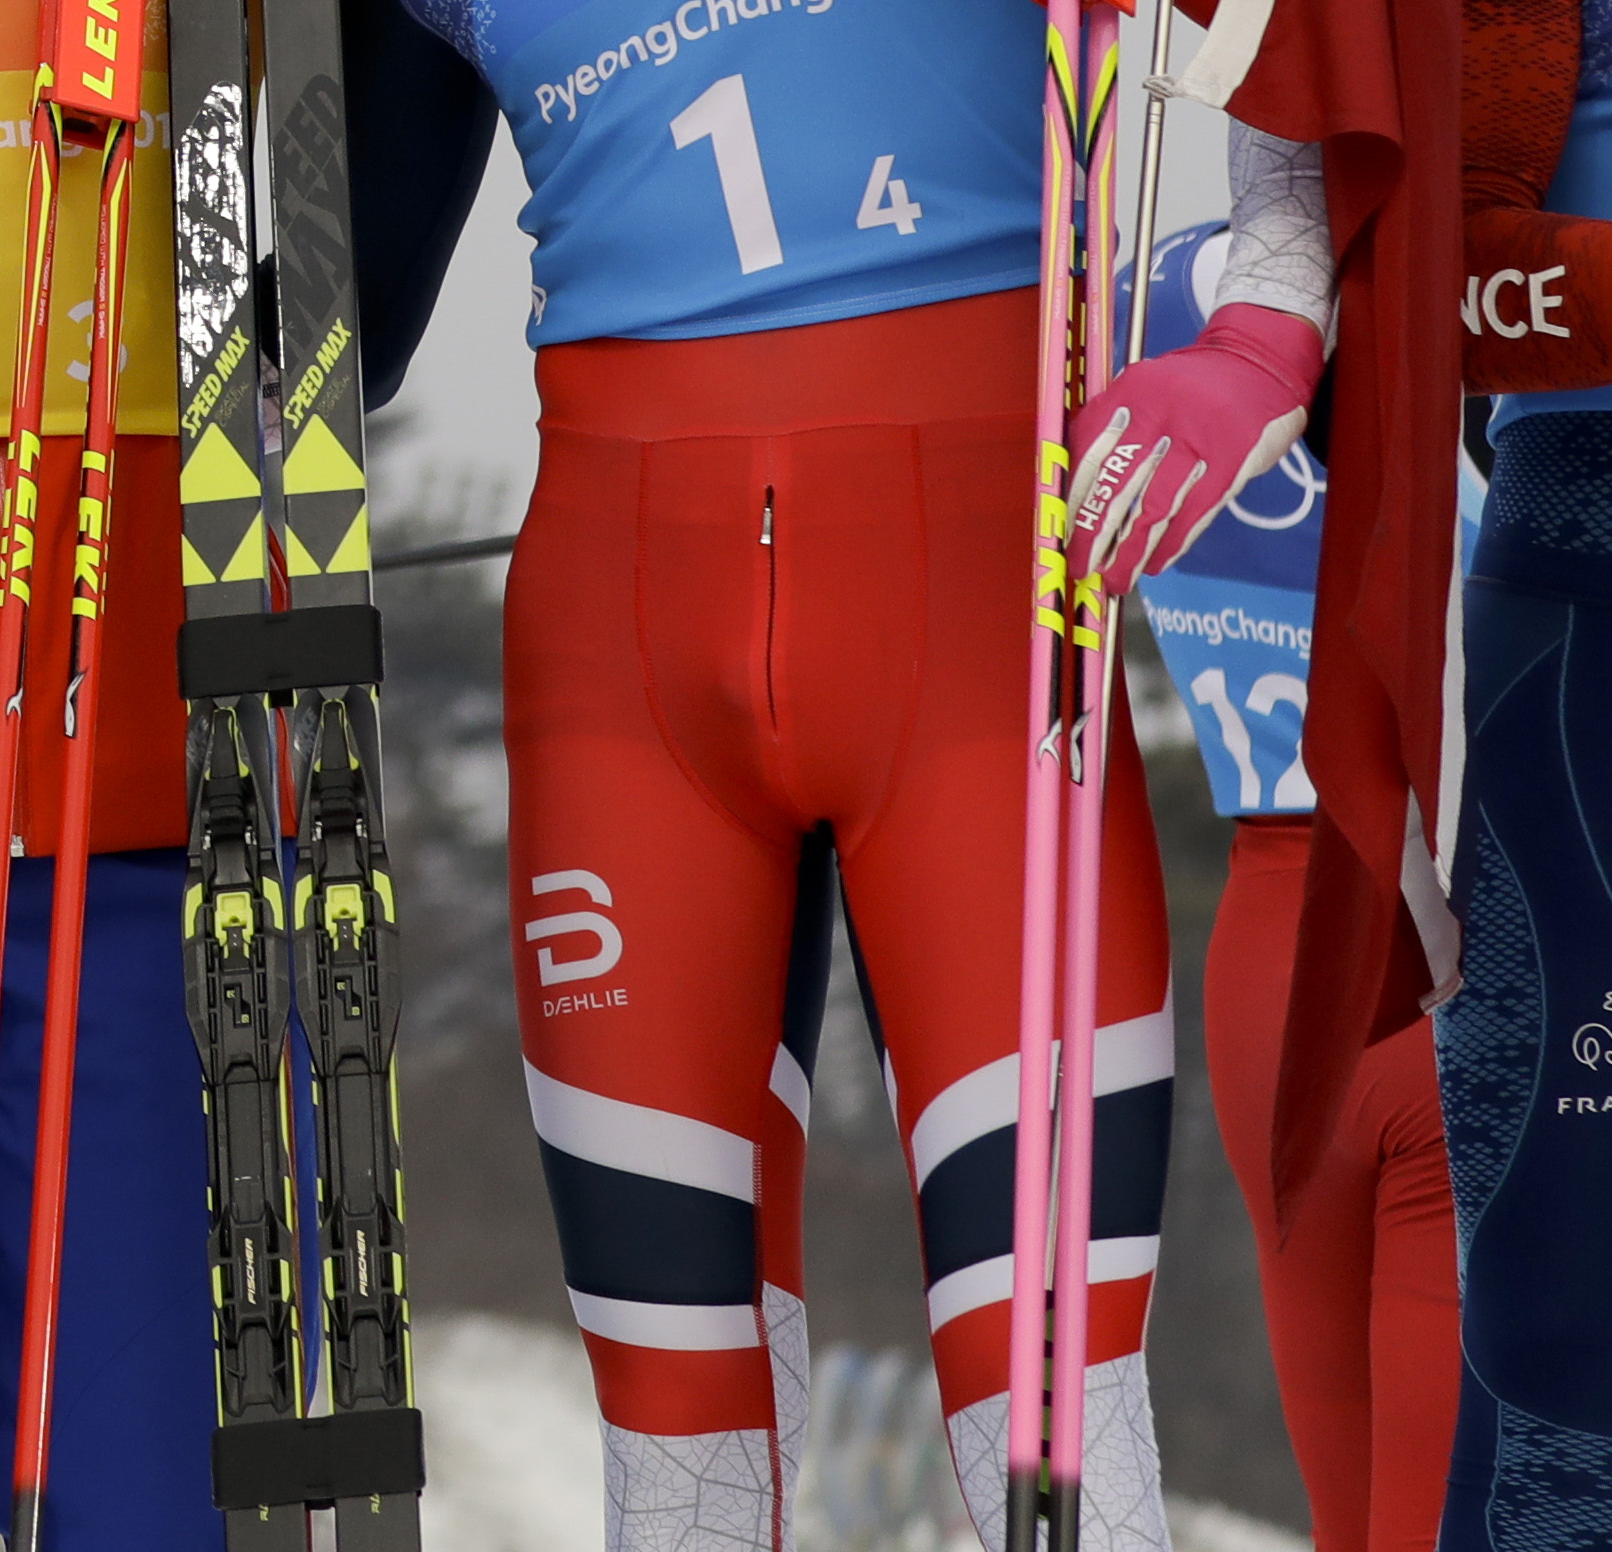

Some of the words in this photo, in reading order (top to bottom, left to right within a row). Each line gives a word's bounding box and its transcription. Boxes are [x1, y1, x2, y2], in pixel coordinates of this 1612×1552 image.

[669, 72, 784, 275] 1
[856, 153, 922, 236] 4
[182, 370, 223, 439] SPEED
[214, 325, 251, 384] MAX
[284, 360, 326, 430] SPEED
[316, 317, 353, 375] MAX
[9, 429, 41, 607] LEKI
[1076, 442, 1143, 531] HESTRA
[1036, 440, 1070, 639] LEKI
[1072, 573, 1106, 652] KI
[543, 988, 629, 1017] DÆHLIE
[245, 1238, 256, 1305] FISCHER
[359, 1230, 369, 1297] FISCHER
